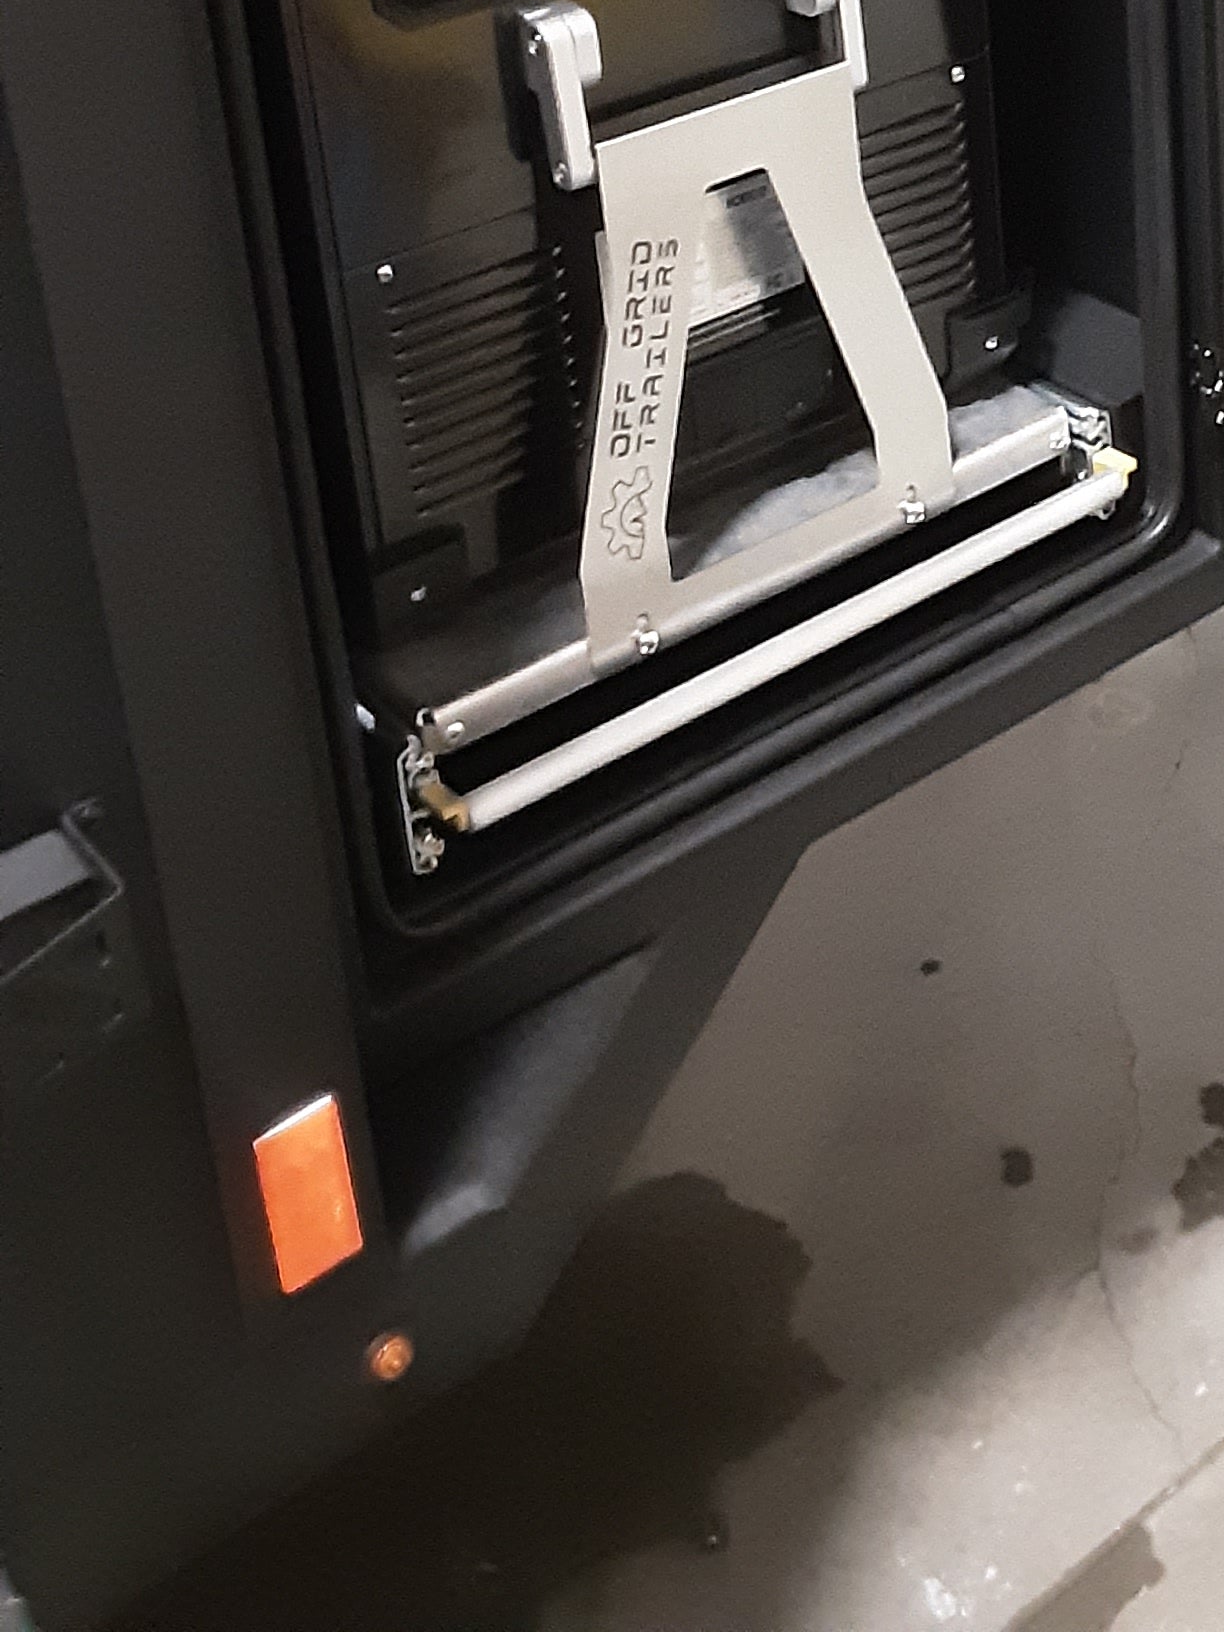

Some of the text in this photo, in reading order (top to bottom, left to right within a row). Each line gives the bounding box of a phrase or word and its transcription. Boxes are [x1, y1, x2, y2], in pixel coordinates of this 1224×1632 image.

[609, 240, 653, 458] OFF GRID
[636, 238, 680, 454] TRAILERS
